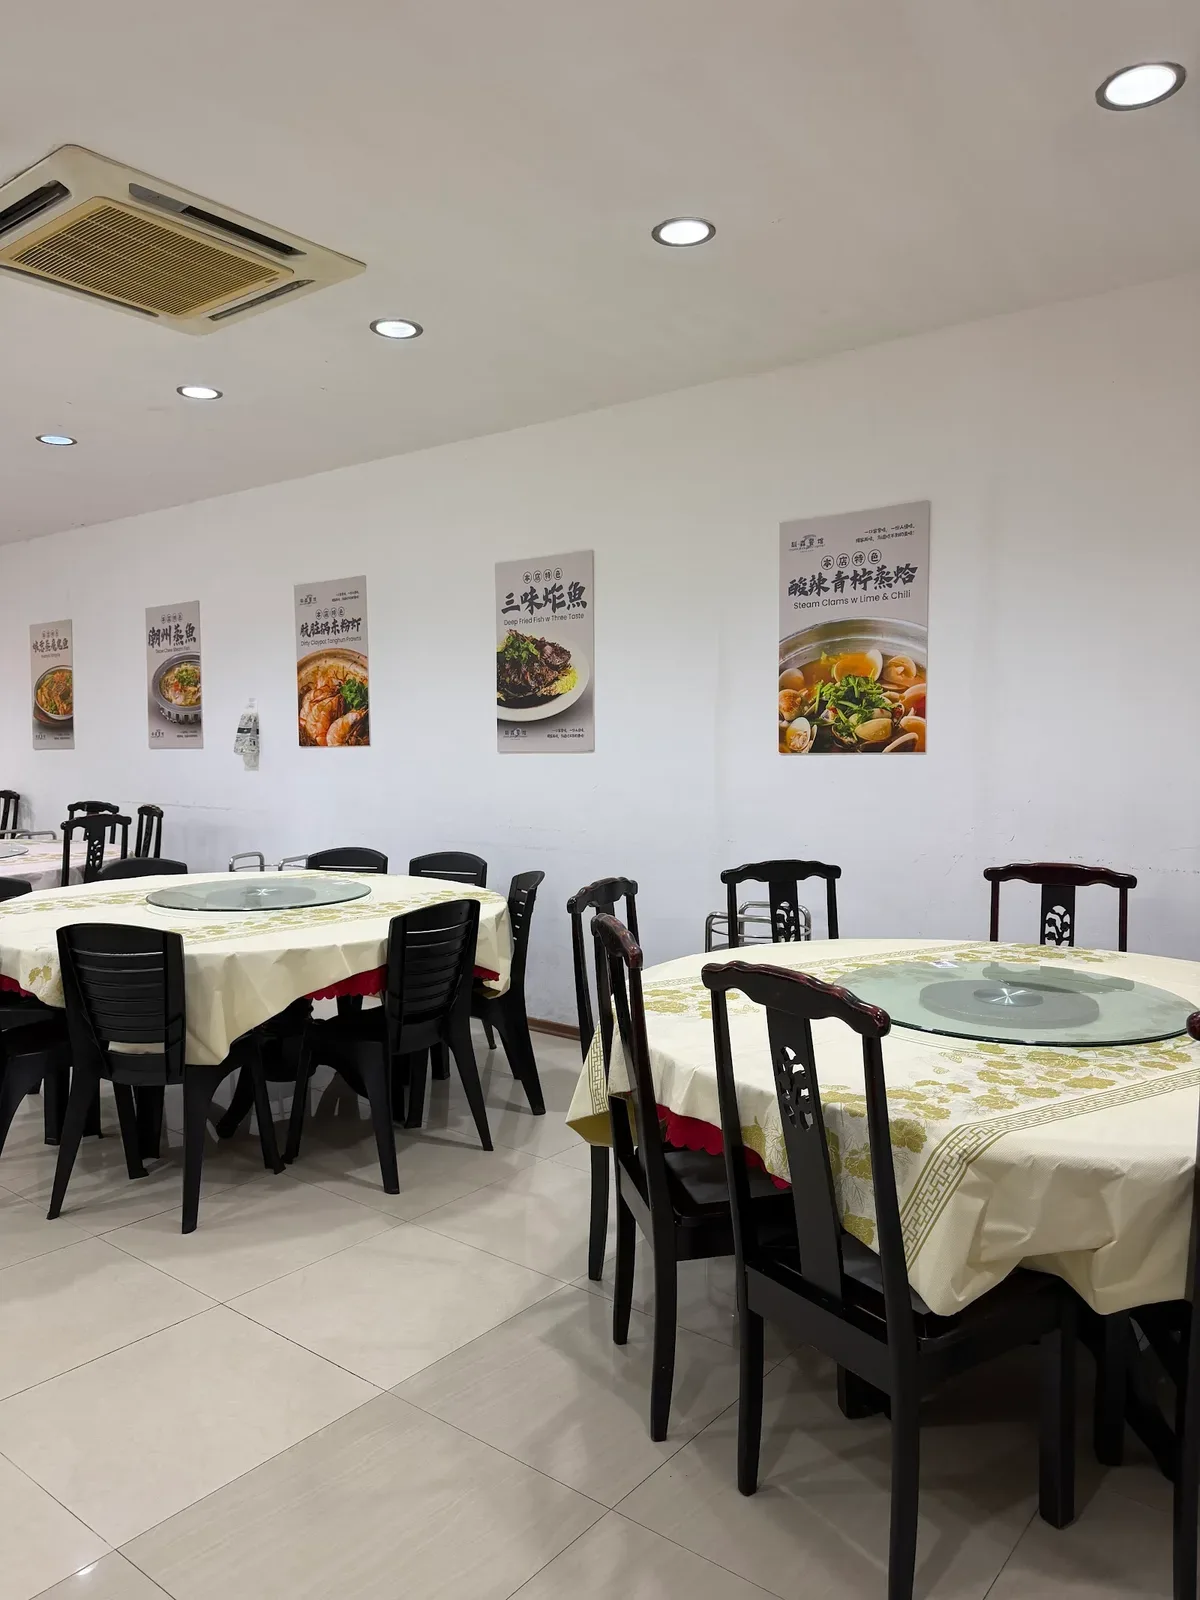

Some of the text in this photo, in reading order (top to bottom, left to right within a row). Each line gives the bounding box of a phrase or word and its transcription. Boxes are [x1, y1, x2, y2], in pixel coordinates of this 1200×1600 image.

[821, 549, 882, 570] 本店特色
[793, 600, 820, 610] Steam
[822, 597, 849, 607] Clams
[860, 594, 880, 603] Lime
[882, 592, 889, 601] &
[891, 589, 911, 600] Chili
